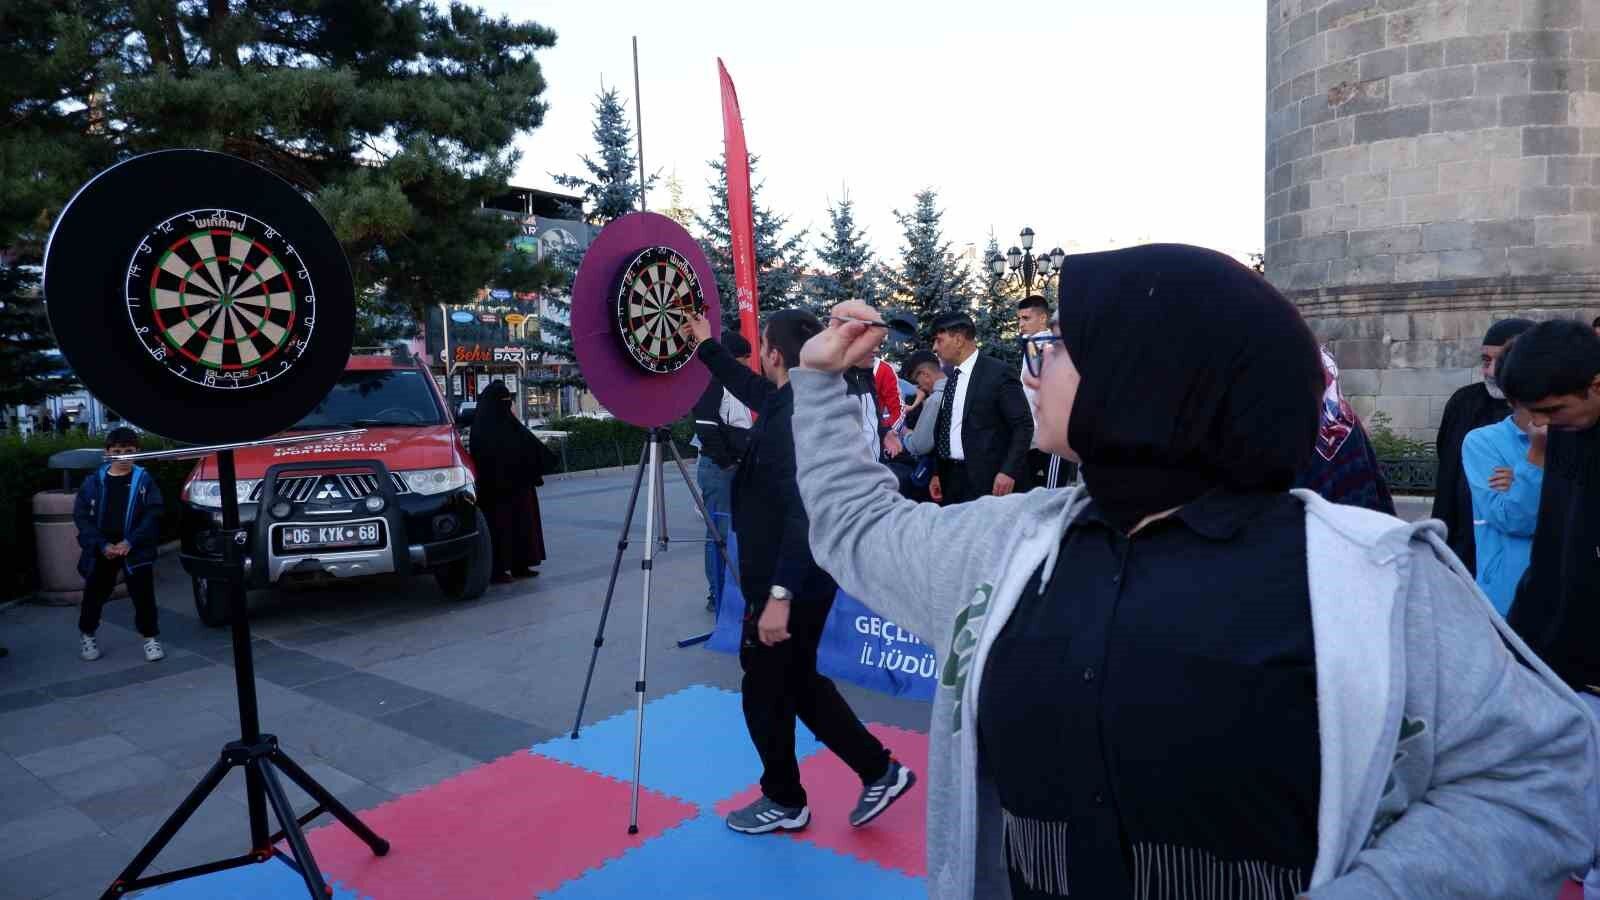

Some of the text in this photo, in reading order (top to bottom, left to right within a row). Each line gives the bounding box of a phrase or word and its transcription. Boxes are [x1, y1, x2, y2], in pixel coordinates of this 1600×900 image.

[160, 222, 174, 234] 12
[263, 227, 276, 239] 18
[494, 352, 540, 361] PAZAR
[293, 526, 376, 544] 06 KYK 68
[860, 641, 874, 666] İL
